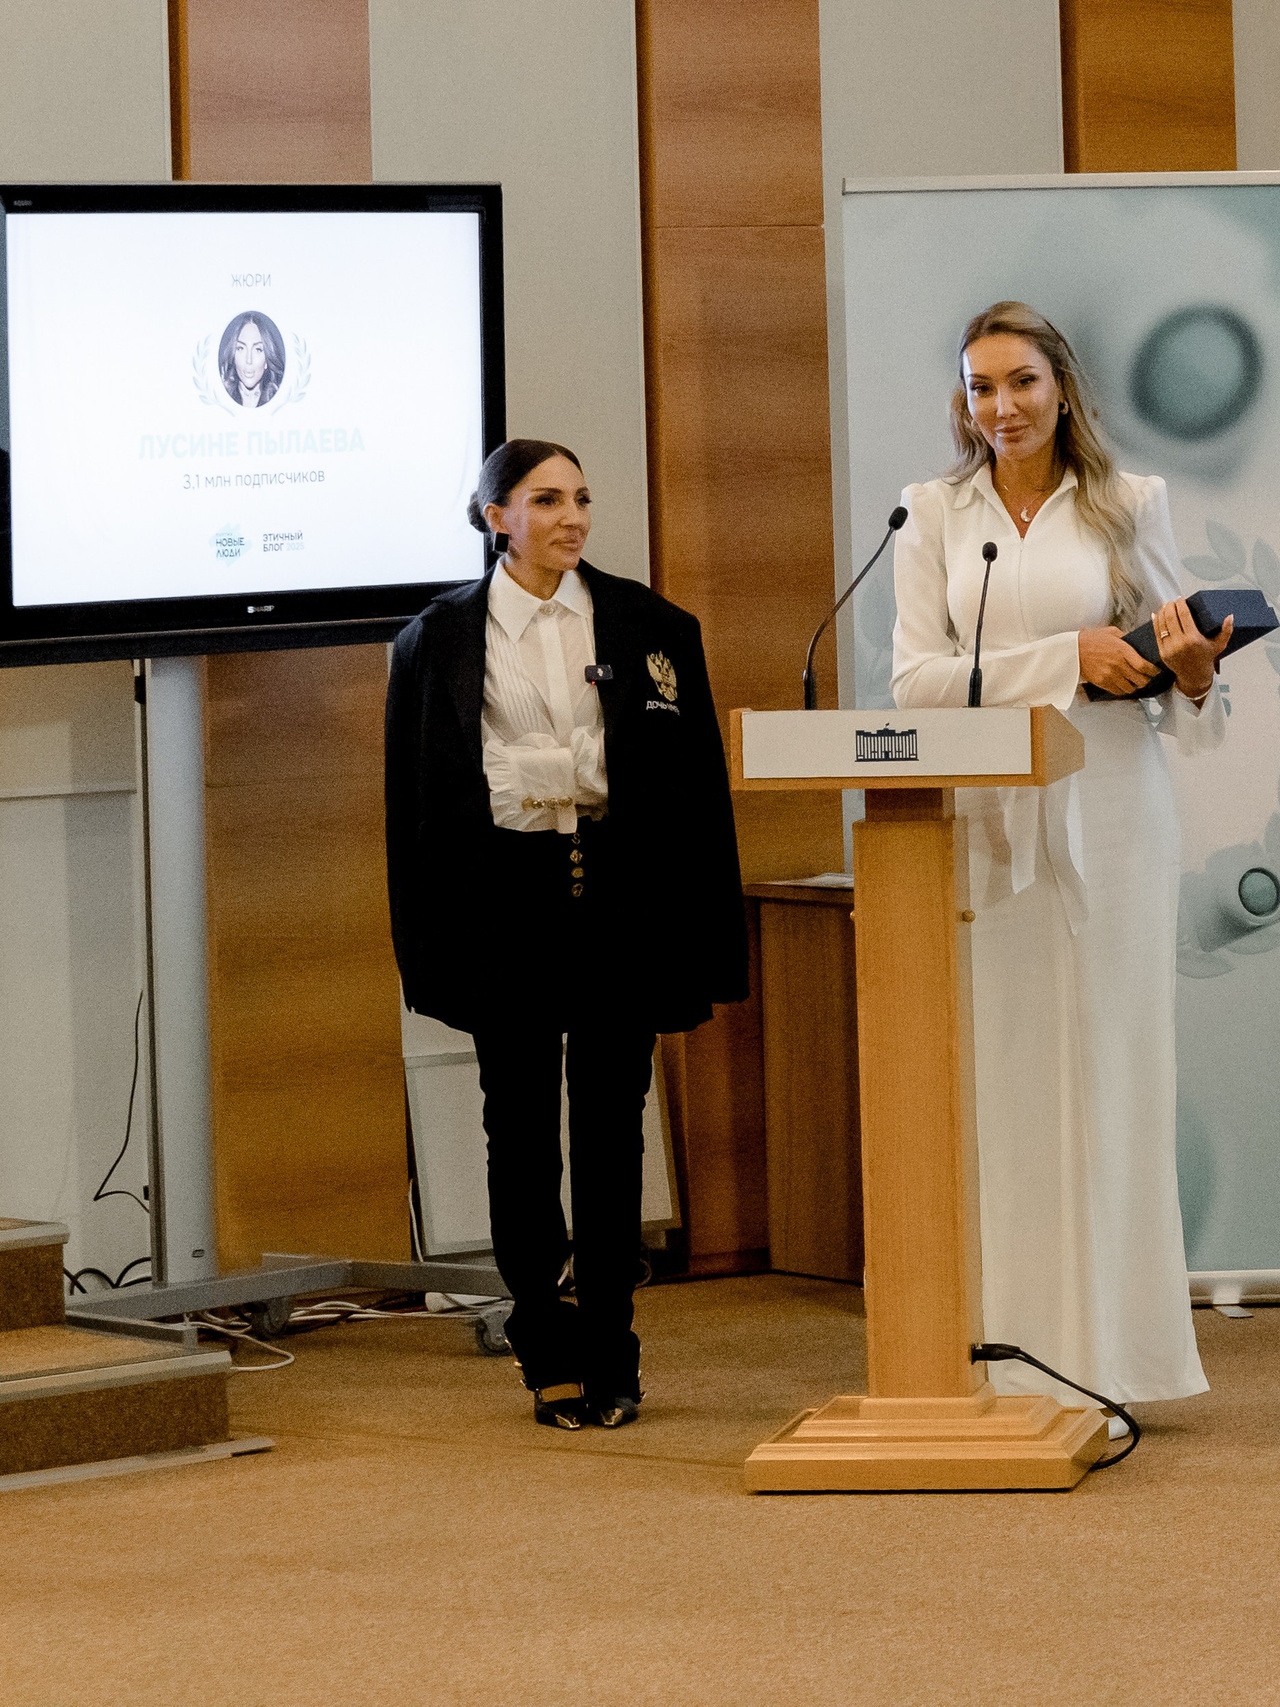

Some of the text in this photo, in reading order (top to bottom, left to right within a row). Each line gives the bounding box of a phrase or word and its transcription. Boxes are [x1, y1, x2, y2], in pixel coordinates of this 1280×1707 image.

[231, 273, 272, 288] ЖЮРИ
[138, 427, 366, 460] ЛУСИНЕ ПЫЛАЕВА
[183, 473, 200, 490] 3,1
[215, 537, 245, 547] НОВЫЕ
[262, 529, 304, 542] ЭТИЧНЫЙ
[215, 547, 241, 558] ЛЮДИ
[262, 542, 284, 553] БЛОГ
